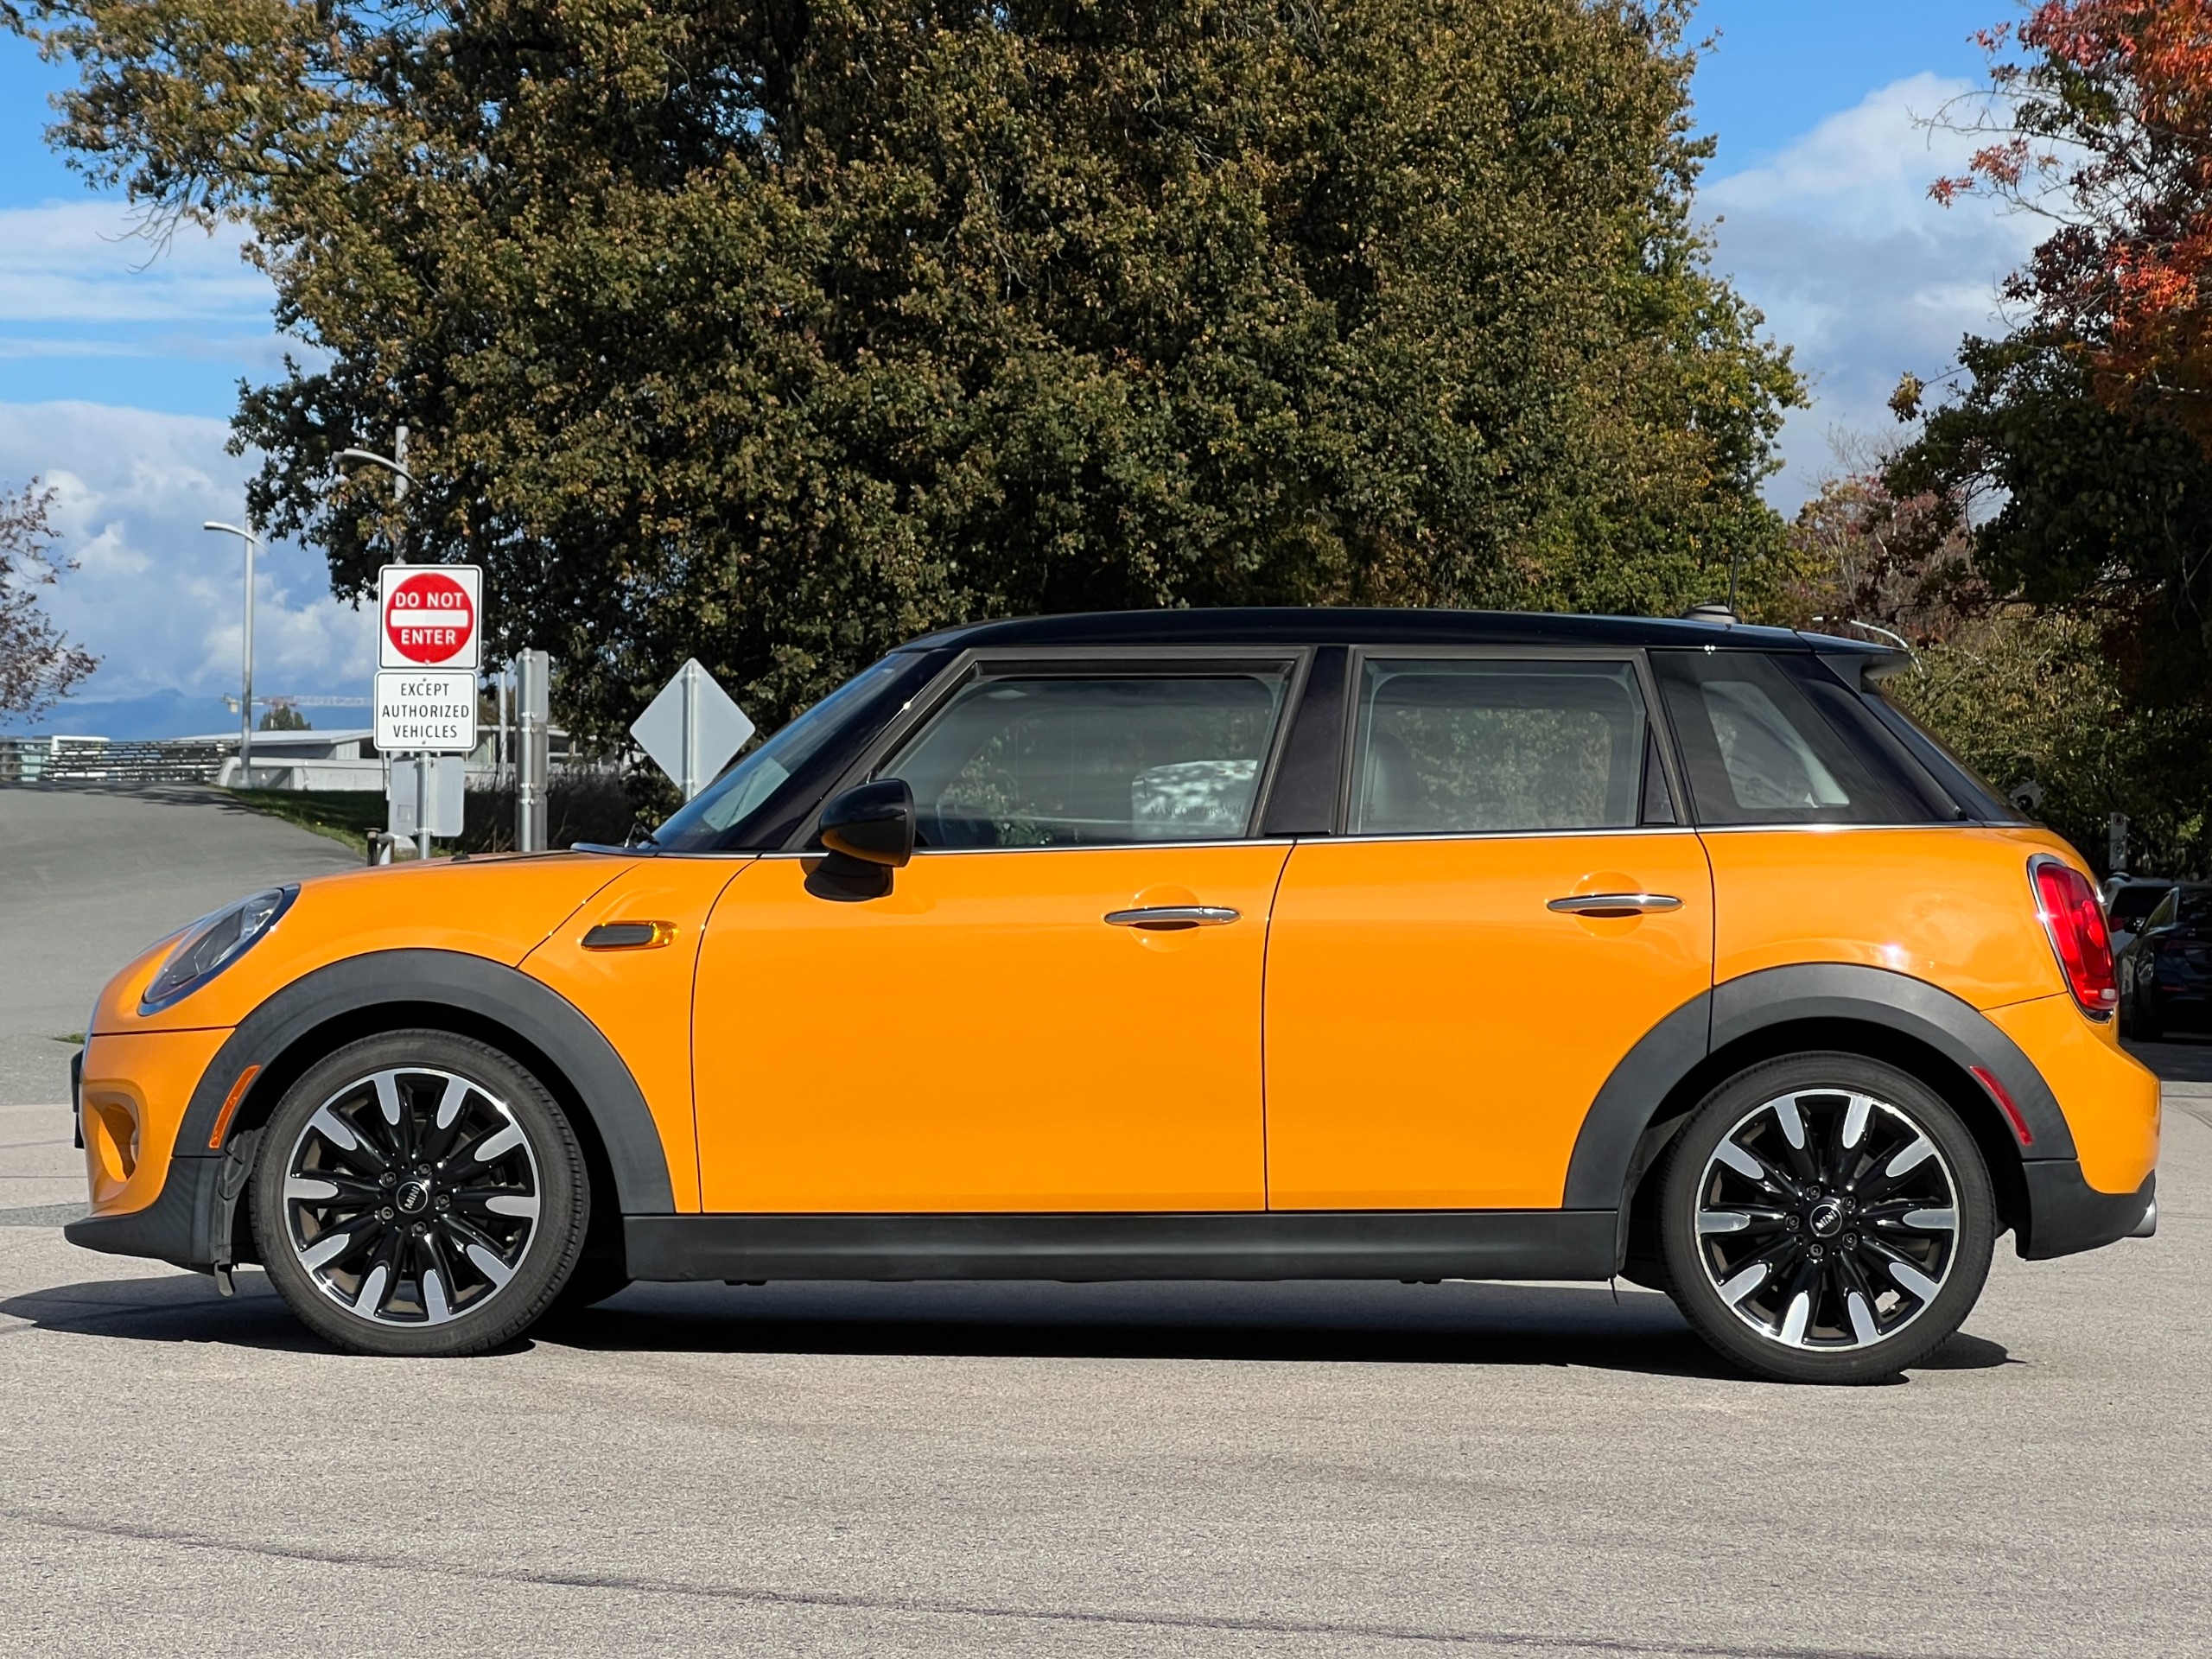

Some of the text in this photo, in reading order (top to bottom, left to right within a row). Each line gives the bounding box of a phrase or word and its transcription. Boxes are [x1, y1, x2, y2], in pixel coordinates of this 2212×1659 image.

[395, 592, 463, 607] DO NOT
[401, 629, 456, 645] ENTER
[400, 683, 449, 696] EXCEPT
[382, 704, 469, 718] AUTHORIZED
[393, 724, 457, 738] VEHICLES
[404, 1185, 420, 1209] MINI
[1815, 1210, 1837, 1230] MINI
